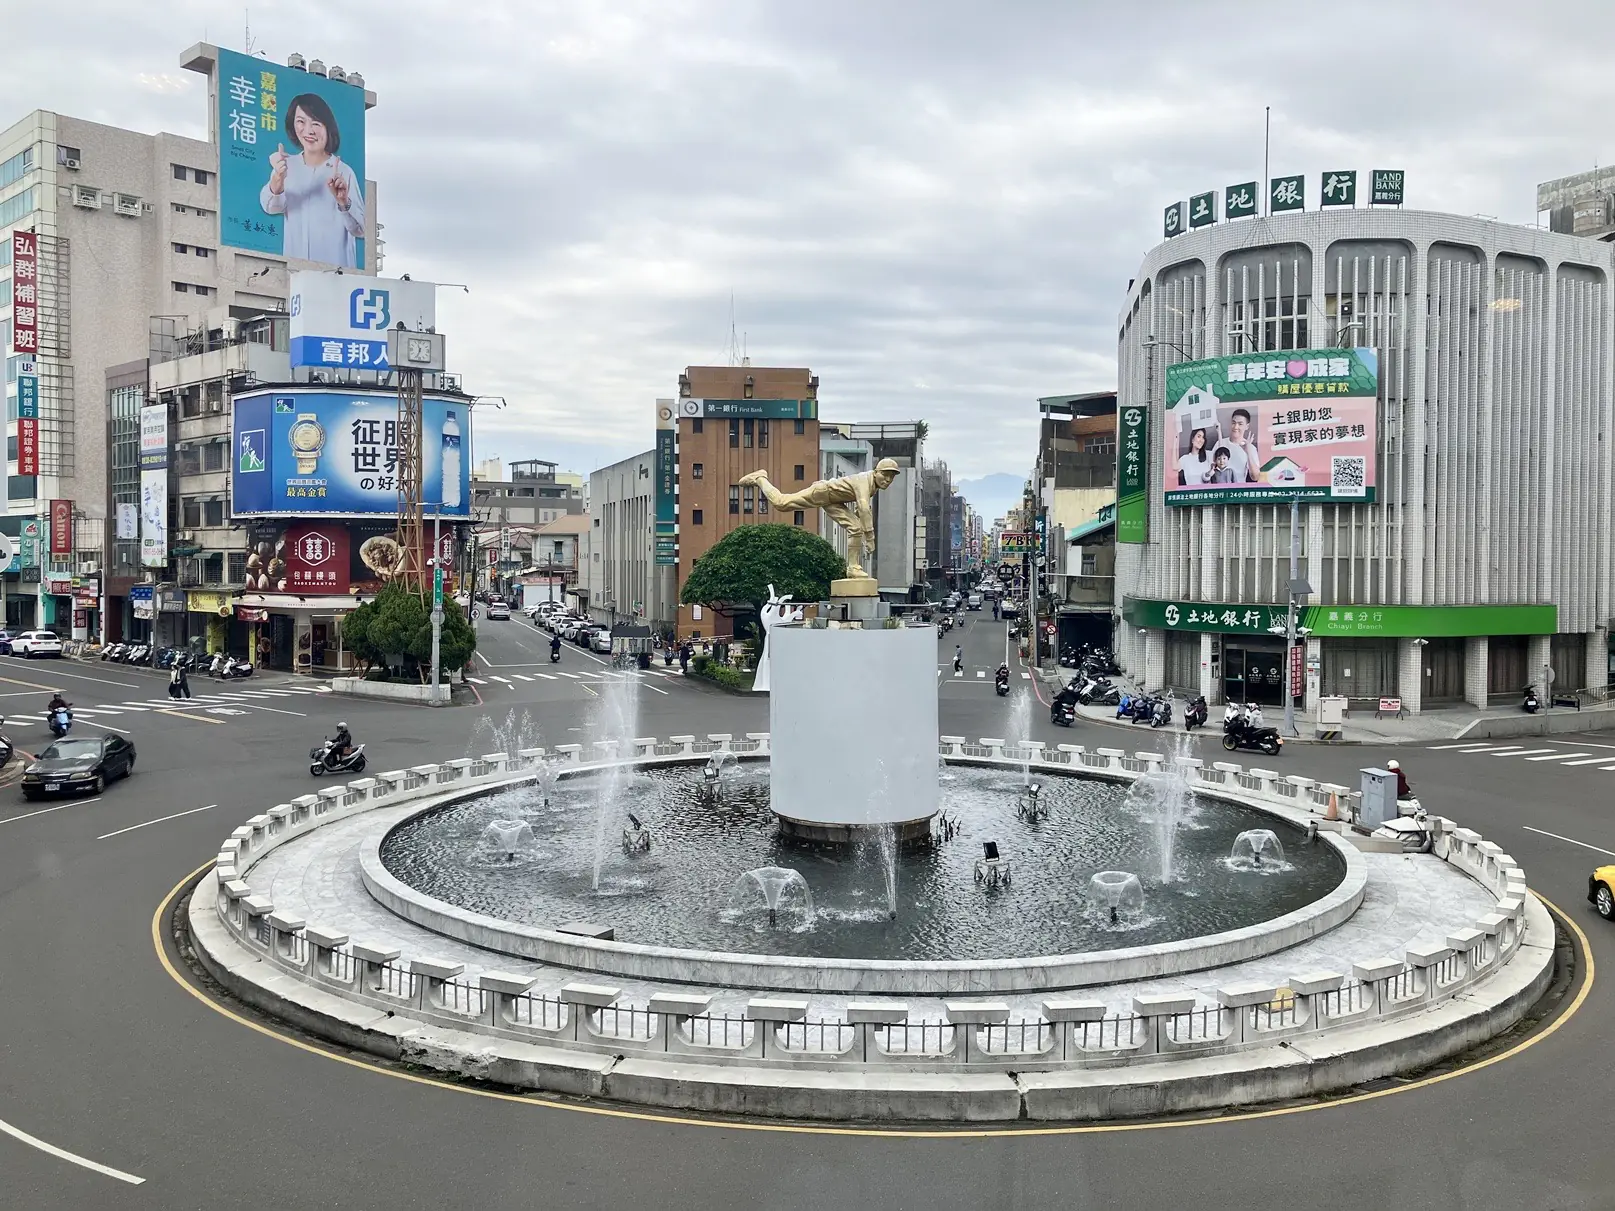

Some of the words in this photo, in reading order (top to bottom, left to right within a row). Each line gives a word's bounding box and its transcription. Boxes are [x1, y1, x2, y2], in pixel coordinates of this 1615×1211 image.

[229, 76, 256, 144] 幸福
[1376, 172, 1401, 180] LAND
[1376, 181, 1401, 190] BANK
[1192, 173, 1352, 221] 土地銀行
[15, 237, 35, 348] 弘群補習班
[321, 341, 388, 365] 富邦人
[23, 379, 33, 416] 聯邦銀行
[1278, 383, 1349, 395] 購屋優惠貸款
[708, 404, 738, 413] 第一銀行
[1272, 407, 1332, 425] 土銀助您
[1274, 425, 1365, 446] 實現家的夢想
[1126, 429, 1139, 477] 土地銀行
[287, 487, 327, 497] 最高金賞
[56, 504, 67, 549] Canon
[1187, 610, 1260, 629] 土地銀行
[1328, 622, 1352, 630] Chiayi
[1329, 612, 1382, 621] 嘉義分行
